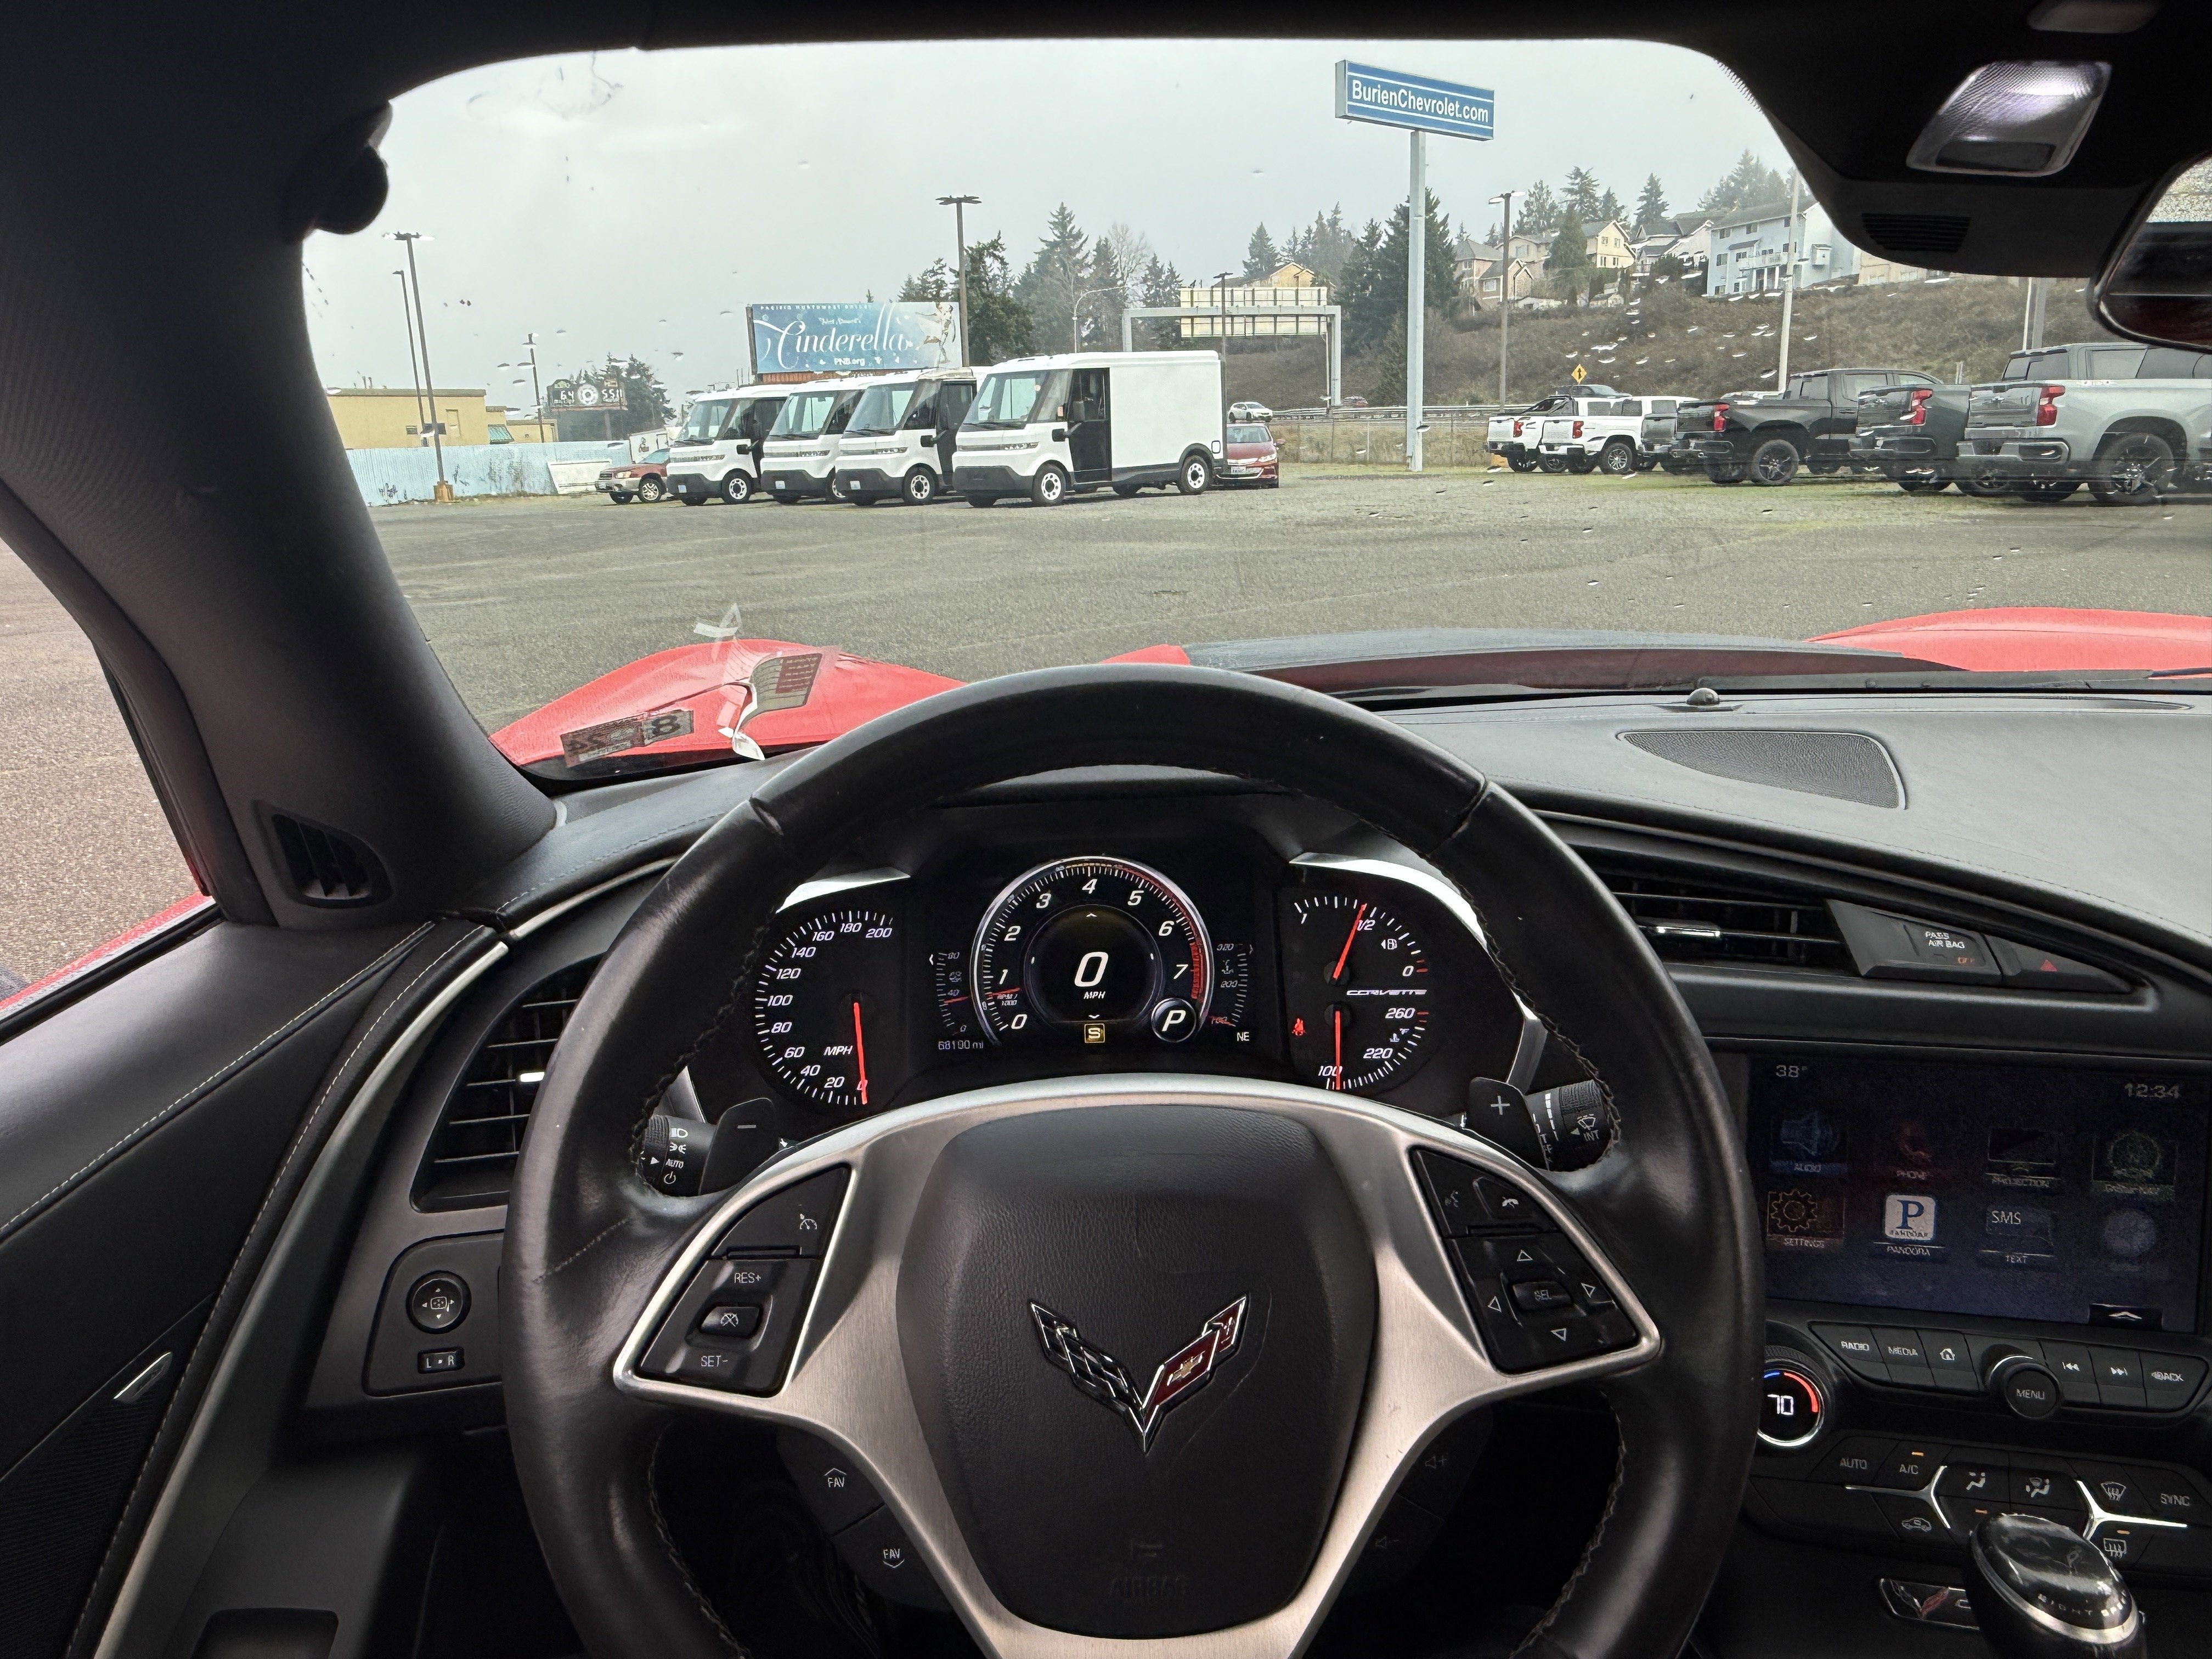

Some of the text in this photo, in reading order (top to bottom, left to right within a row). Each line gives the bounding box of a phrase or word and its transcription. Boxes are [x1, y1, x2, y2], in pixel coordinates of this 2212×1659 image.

[1352, 80, 1488, 122] BurienChevrolet.com
[1082, 879, 1097, 894] 4
[1036, 893, 1052, 909] 3
[1127, 890, 1144, 906] 5
[1301, 913, 1307, 924] 1
[840, 923, 862, 933] 180
[866, 928, 892, 938] 200
[1004, 926, 1021, 941] 2
[1159, 921, 1175, 936] 6
[812, 931, 834, 941] 160
[1925, 931, 1950, 940] PASS
[1945, 940, 1965, 949] BAG
[792, 947, 816, 958] 140
[776, 968, 801, 979] 120
[1074, 952, 1109, 988] 0
[1173, 964, 1188, 980] 7
[1402, 966, 1414, 977] 0
[998, 969, 1008, 984] 1
[768, 995, 793, 1006] 100
[1084, 991, 1105, 999] MPH
[1385, 1008, 1415, 1019] 260
[1011, 1014, 1028, 1030] 0
[1162, 1010, 1186, 1032] P
[771, 1022, 793, 1033] 80
[1088, 1028, 1102, 1039] S
[1236, 1032, 1250, 1041] NE
[938, 1040, 970, 1049] 68100
[784, 1047, 805, 1058] 60
[823, 1046, 853, 1056] MPH
[1363, 1048, 1393, 1059] 220
[800, 1065, 821, 1076] 40
[1318, 1065, 1343, 1076] 100
[824, 1076, 845, 1088] 20
[2124, 1082, 2181, 1099] 12:34
[1583, 1130, 1599, 1142] INT
[665, 1158, 684, 1169] AUTO
[1896, 1199, 1925, 1229] P
[1991, 1210, 2021, 1224] SMS
[2005, 1254, 2028, 1263] TEXT
[1841, 1341, 1870, 1351] RADIO
[1888, 1346, 1918, 1356] MEDIA
[426, 1355, 454, 1369] L R
[2016, 1388, 2045, 1400] MENU
[1767, 1394, 1794, 1415] 70
[1839, 1457, 1867, 1469] AUTO
[1899, 1464, 1918, 1475] A/C
[828, 1477, 845, 1487] FAV
[2160, 1493, 2190, 1506] SYNC
[883, 1548, 900, 1559] FAV
